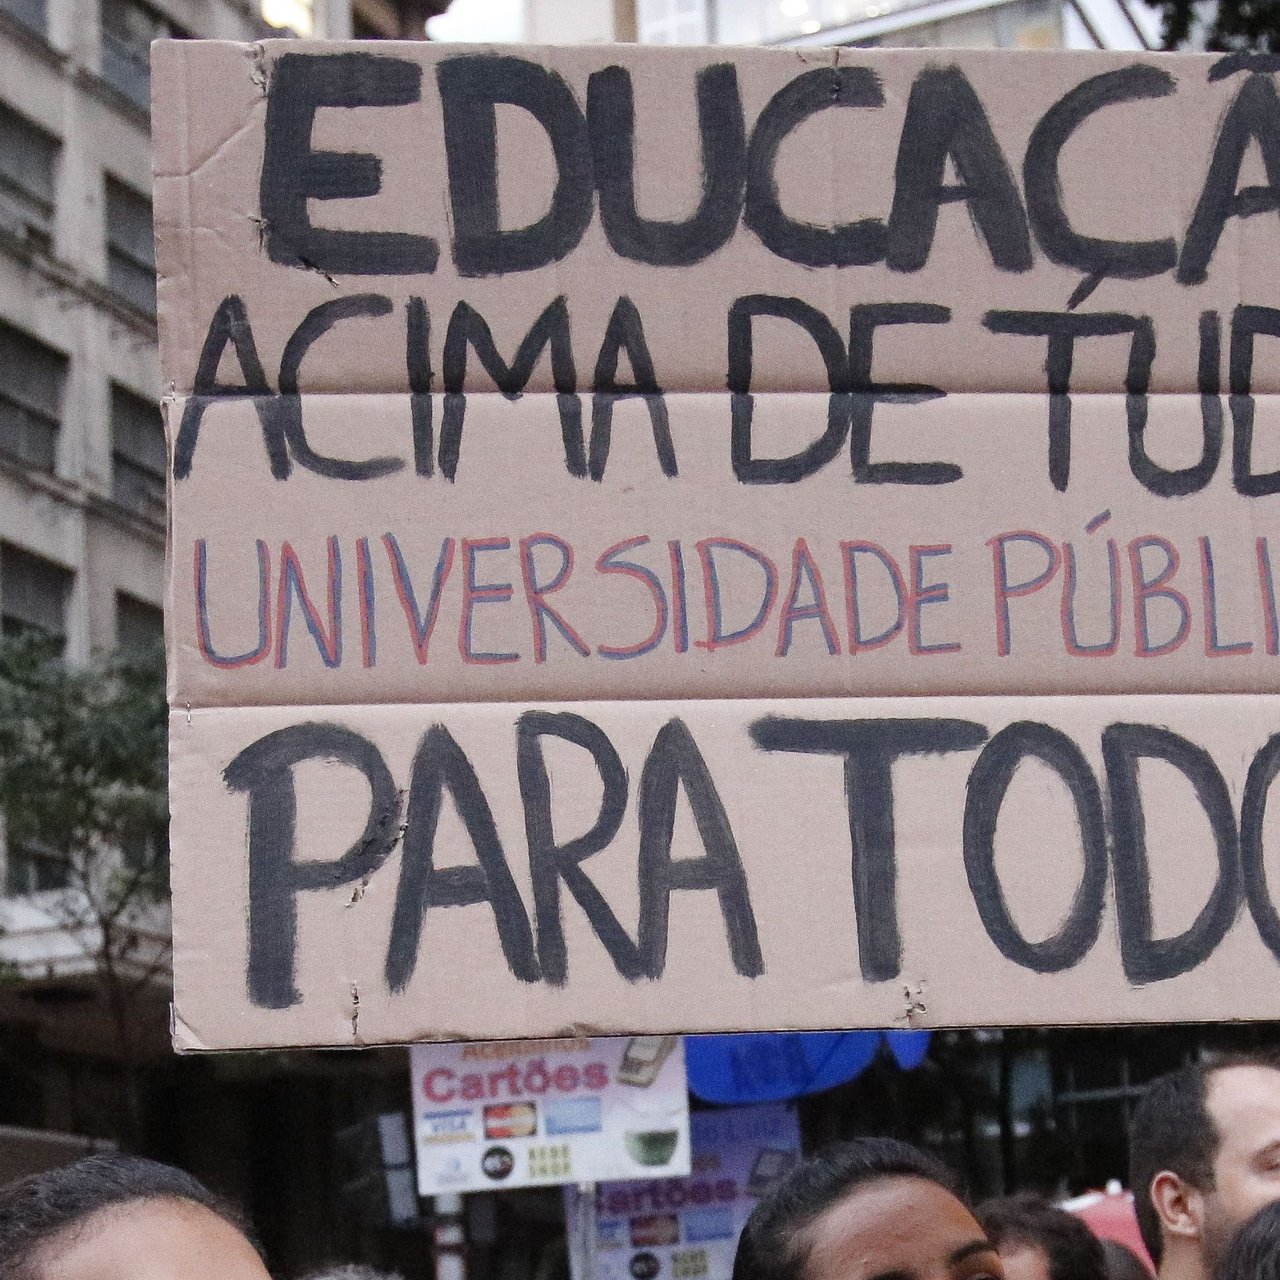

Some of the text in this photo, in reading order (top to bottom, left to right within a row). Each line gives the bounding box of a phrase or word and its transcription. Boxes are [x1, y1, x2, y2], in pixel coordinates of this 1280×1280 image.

[174, 292, 677, 483] ACIMA
[727, 295, 964, 486] DE
[194, 532, 963, 671] UNIVERSIDADE
[222, 709, 765, 1010] PARA
[422, 1058, 610, 1104] Cartões
[595, 1179, 738, 1214] artões
